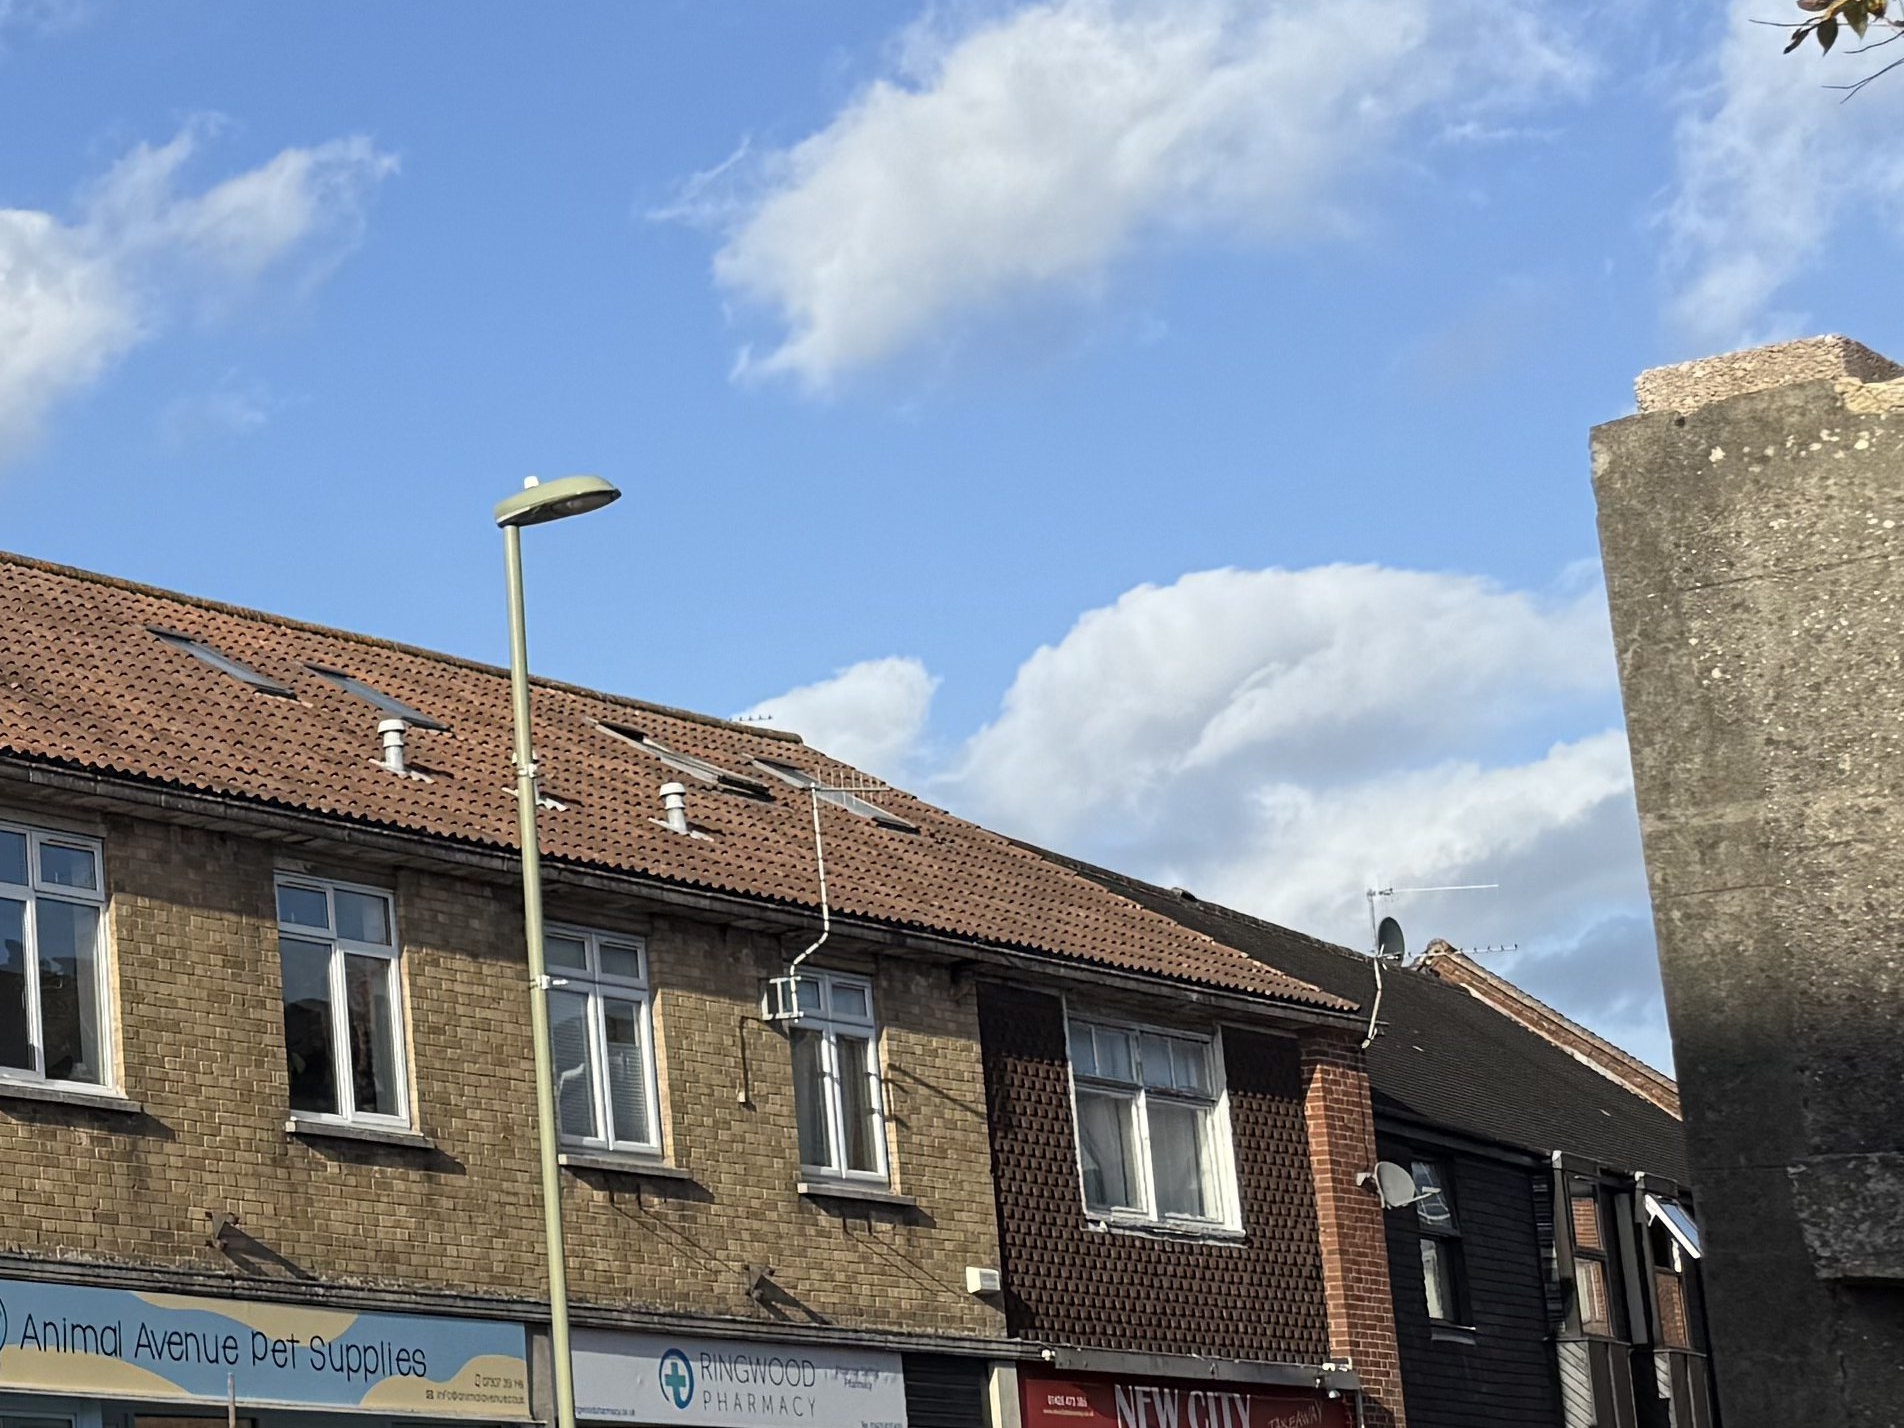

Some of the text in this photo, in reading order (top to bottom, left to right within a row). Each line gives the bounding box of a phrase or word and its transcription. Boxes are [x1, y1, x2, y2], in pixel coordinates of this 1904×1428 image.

[20, 1313, 428, 1381] Animal Avenue Pet Supplies
[700, 1352, 816, 1388] RINGWOOD
[703, 1390, 816, 1418] PHARMACY
